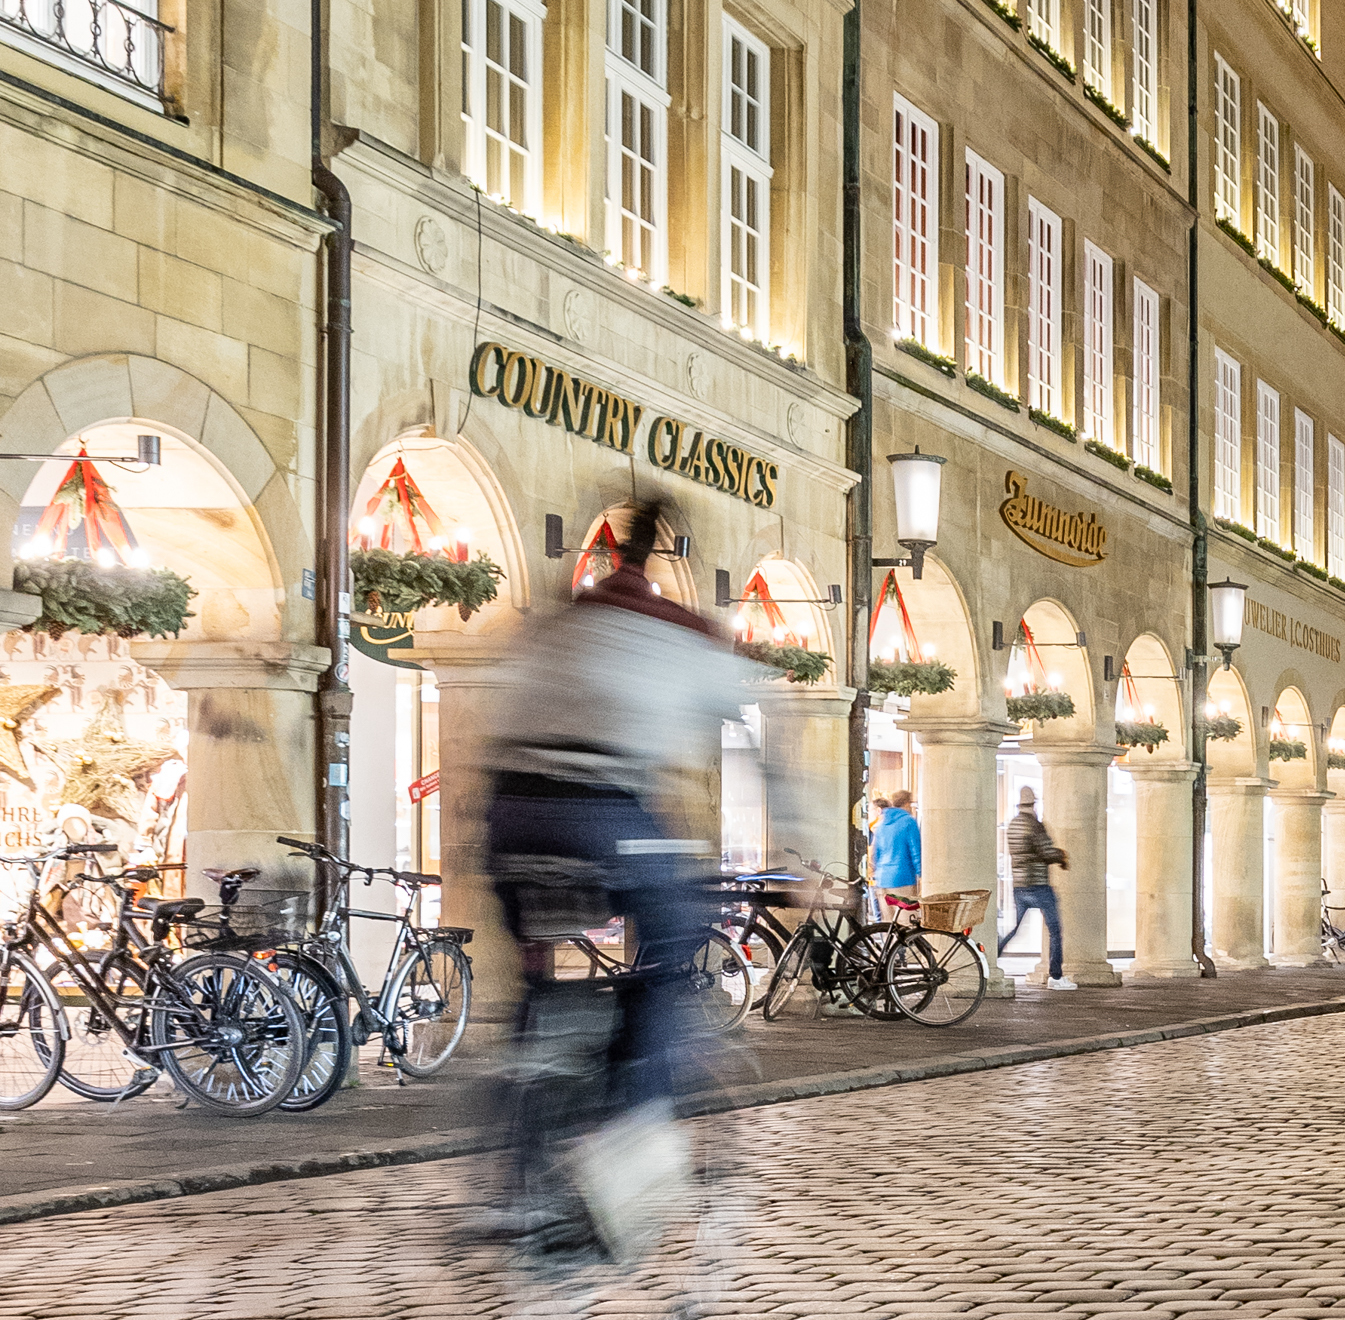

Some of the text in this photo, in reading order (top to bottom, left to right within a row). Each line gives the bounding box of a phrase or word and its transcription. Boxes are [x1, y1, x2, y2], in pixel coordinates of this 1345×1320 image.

[469, 341, 779, 509] COUNTRY CLASSICS
[1244, 596, 1287, 642] UWELIER
